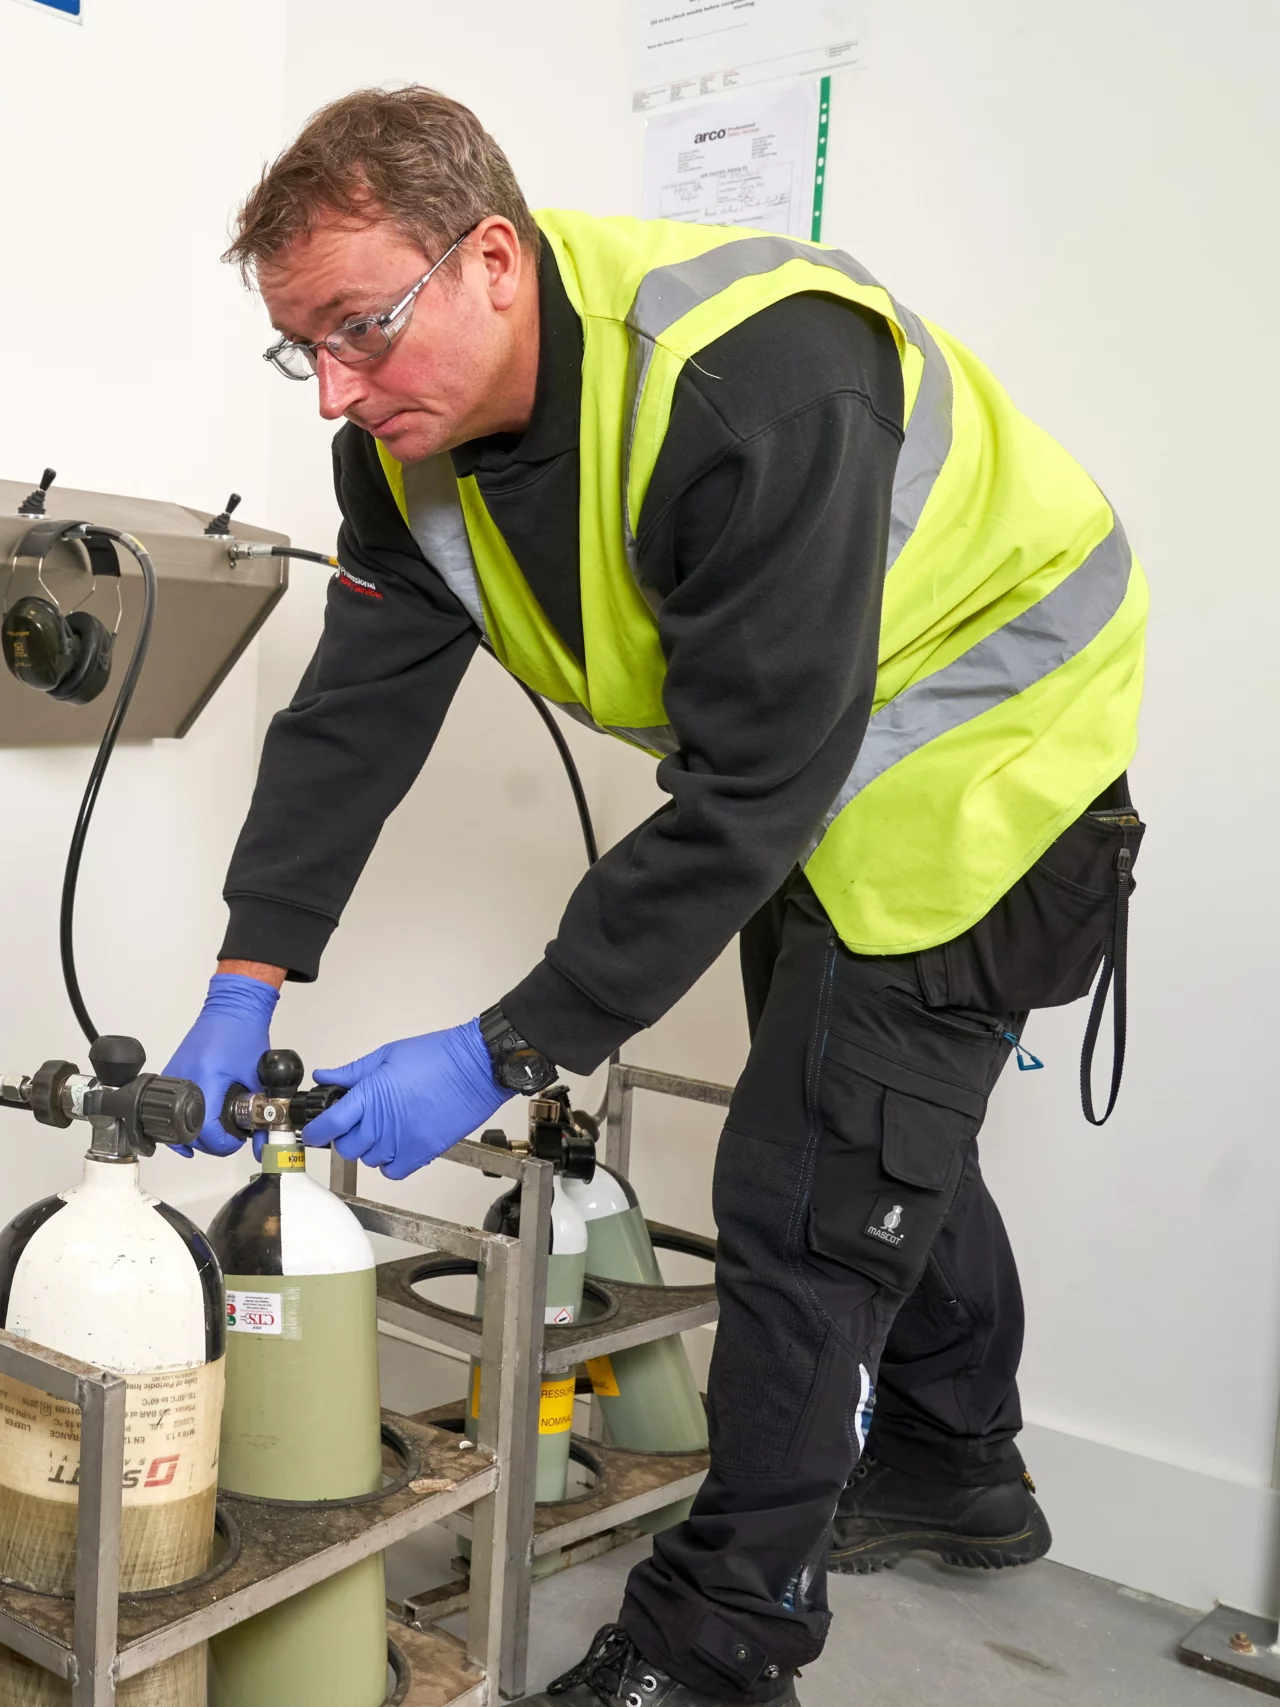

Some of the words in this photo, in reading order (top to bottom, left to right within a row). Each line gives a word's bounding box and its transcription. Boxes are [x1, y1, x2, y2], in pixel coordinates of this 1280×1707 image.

[694, 128, 726, 144] arco
[868, 1226, 902, 1245] MASCOT
[143, 1381, 174, 1391] Periodic
[183, 1377, 198, 1386] Date
[125, 1383, 141, 1391] Insp
[141, 1397, 159, 1405] 60°C
[161, 1396, 168, 1404] to
[55, 1405, 80, 1415] 011/09
[140, 1410, 157, 1418] BAR
[4, 1416, 31, 1432] LUXFER
[49, 1430, 80, 1441] RANCE
[183, 1427, 196, 1437] M18
[134, 1436, 145, 1444] EN
